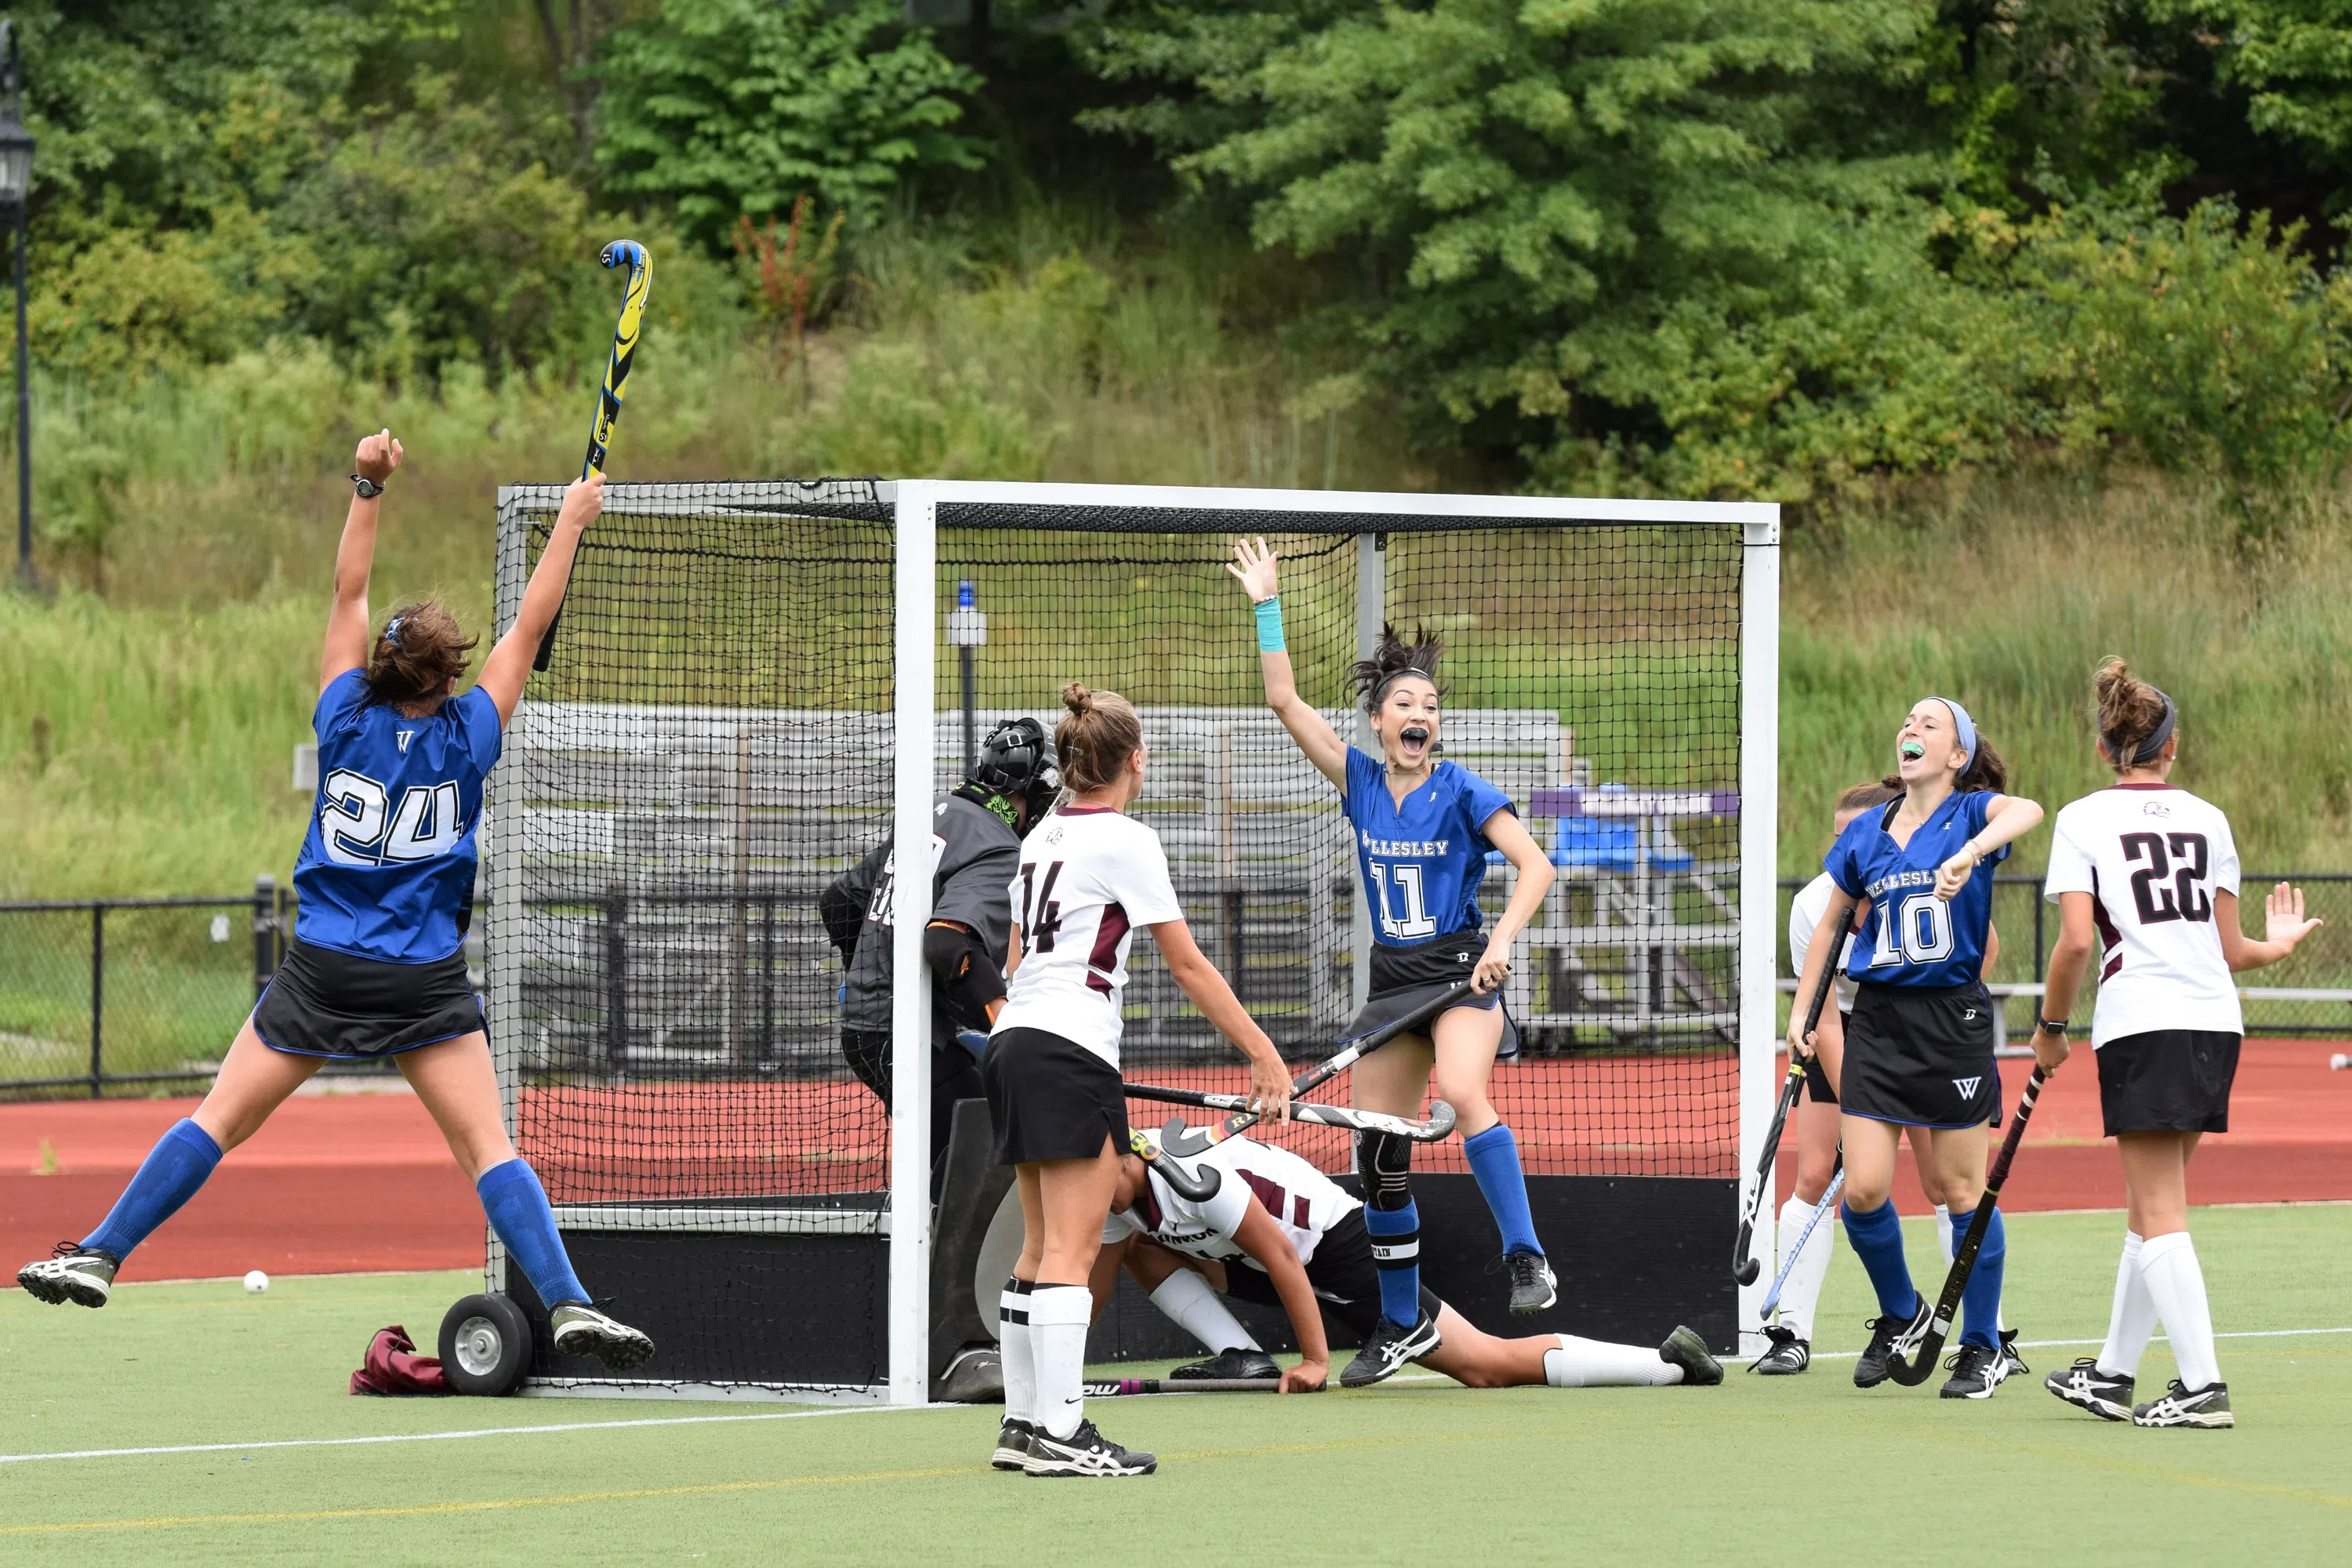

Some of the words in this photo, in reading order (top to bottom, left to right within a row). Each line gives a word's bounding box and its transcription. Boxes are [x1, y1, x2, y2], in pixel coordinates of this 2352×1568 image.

[601, 253, 611, 263] S1
[396, 731, 414, 753] W
[321, 768, 464, 866] 24
[1363, 829, 1449, 857] WLLESLEY
[1369, 858, 1436, 939] 11
[1865, 869, 1940, 898] WELLESL
[2119, 832, 2211, 924] 22
[1020, 861, 1064, 959] 14
[1868, 892, 1954, 968] 10
[1952, 1076, 1982, 1101] W
